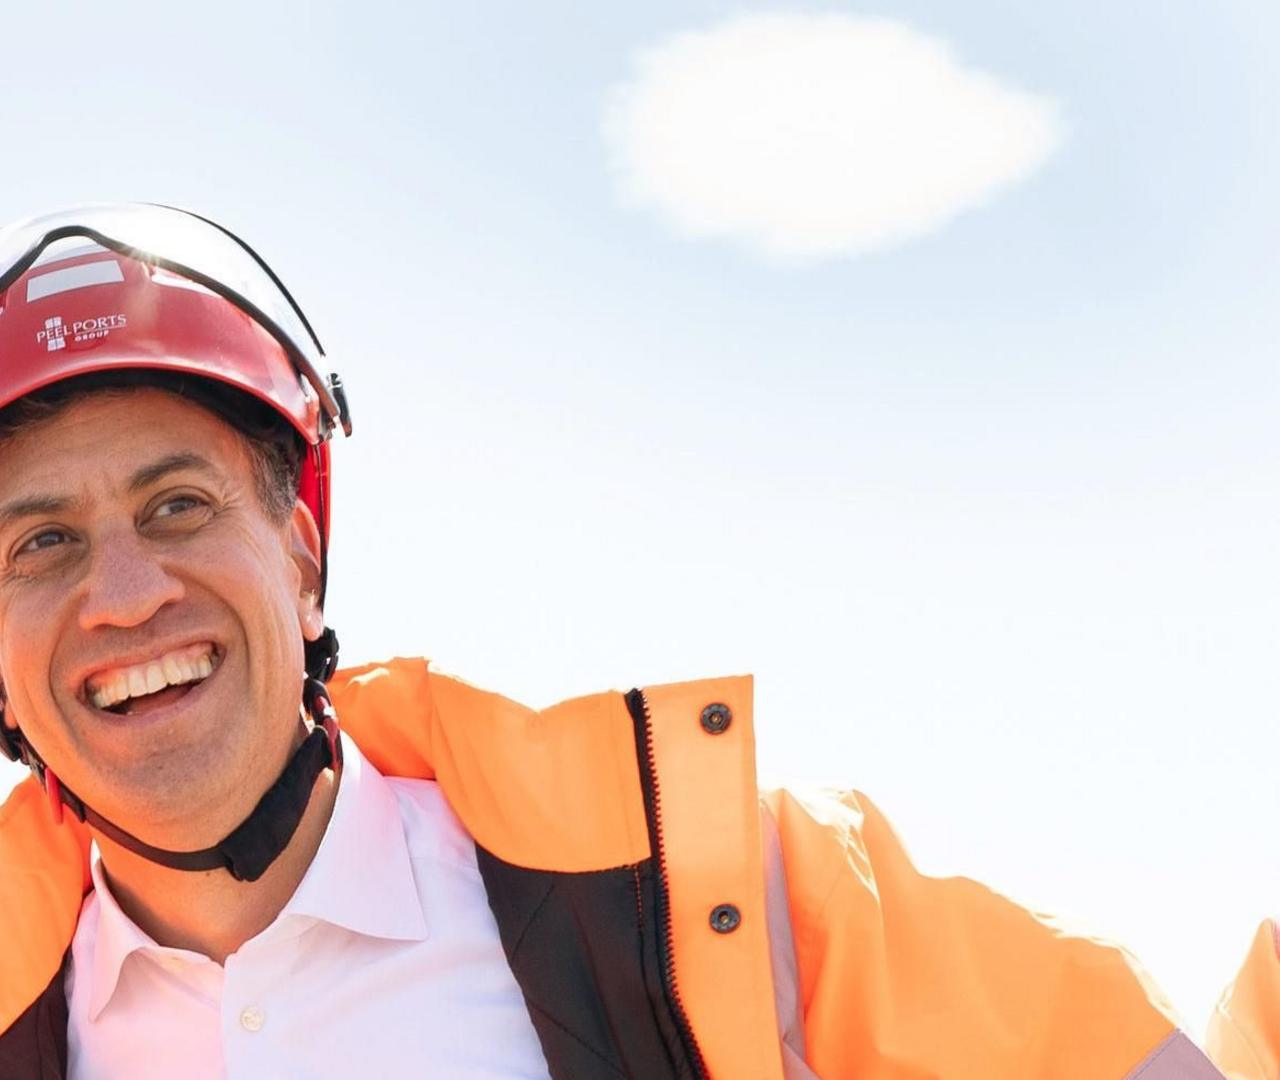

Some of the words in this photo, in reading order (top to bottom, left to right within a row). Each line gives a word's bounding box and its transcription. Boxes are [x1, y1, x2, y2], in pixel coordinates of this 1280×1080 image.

[37, 325, 72, 343] PEEL
[73, 314, 127, 333] PORTS
[75, 330, 110, 342] GROUP
